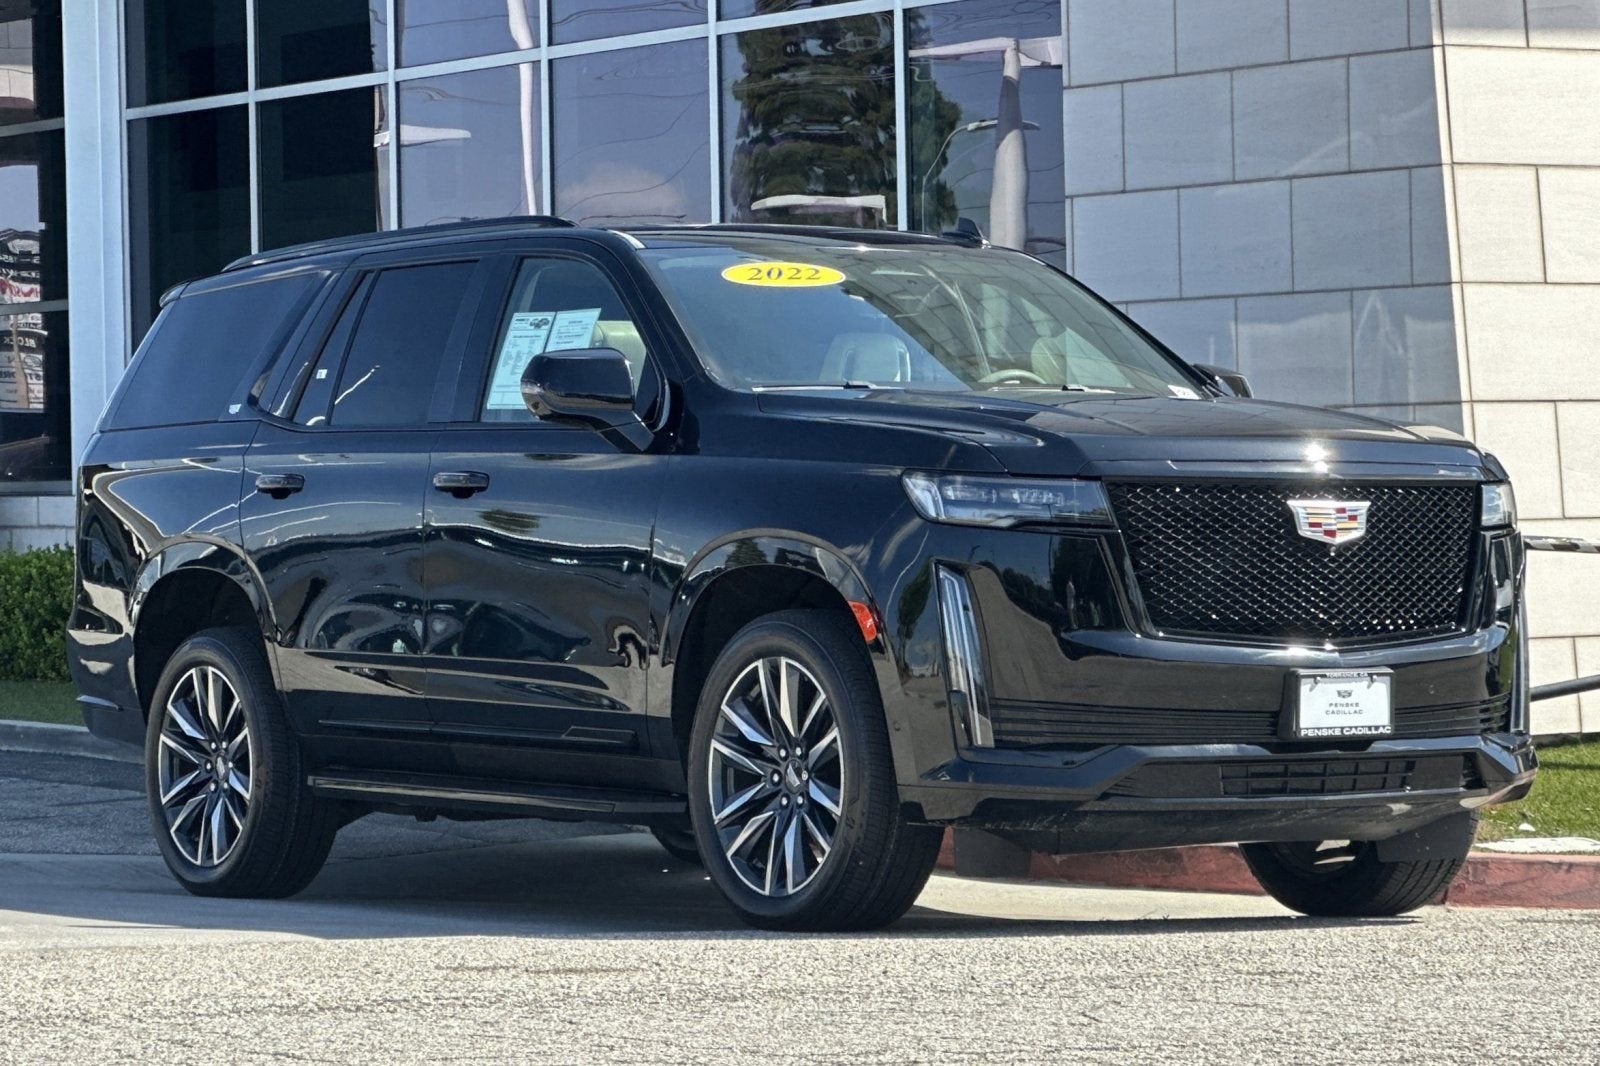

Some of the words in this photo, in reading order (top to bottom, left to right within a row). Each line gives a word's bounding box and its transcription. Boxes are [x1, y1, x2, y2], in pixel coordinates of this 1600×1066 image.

[748, 267, 821, 281] 2022
[1301, 727, 1342, 737] PENSKE
[1343, 726, 1392, 736] CADILLAC
